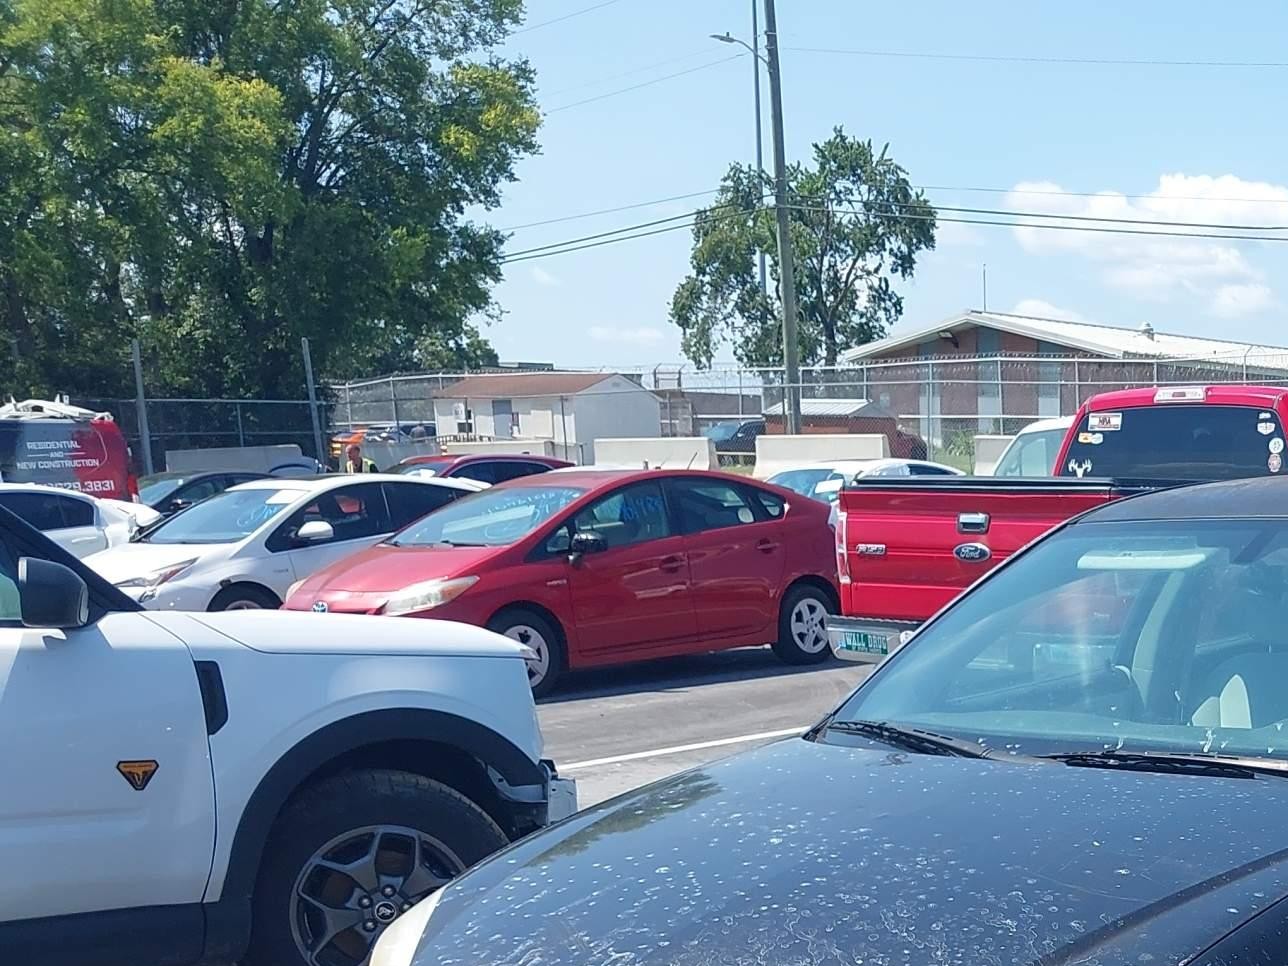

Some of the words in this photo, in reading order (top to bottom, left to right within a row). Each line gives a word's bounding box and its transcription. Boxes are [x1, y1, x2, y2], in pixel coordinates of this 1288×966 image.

[27, 440, 81, 450] RESIDENTIAL
[17, 460, 37, 469] NEW
[38, 459, 99, 469] CONSTRUCTION
[959, 546, 980, 558] Ford
[845, 632, 866, 647] WALL
